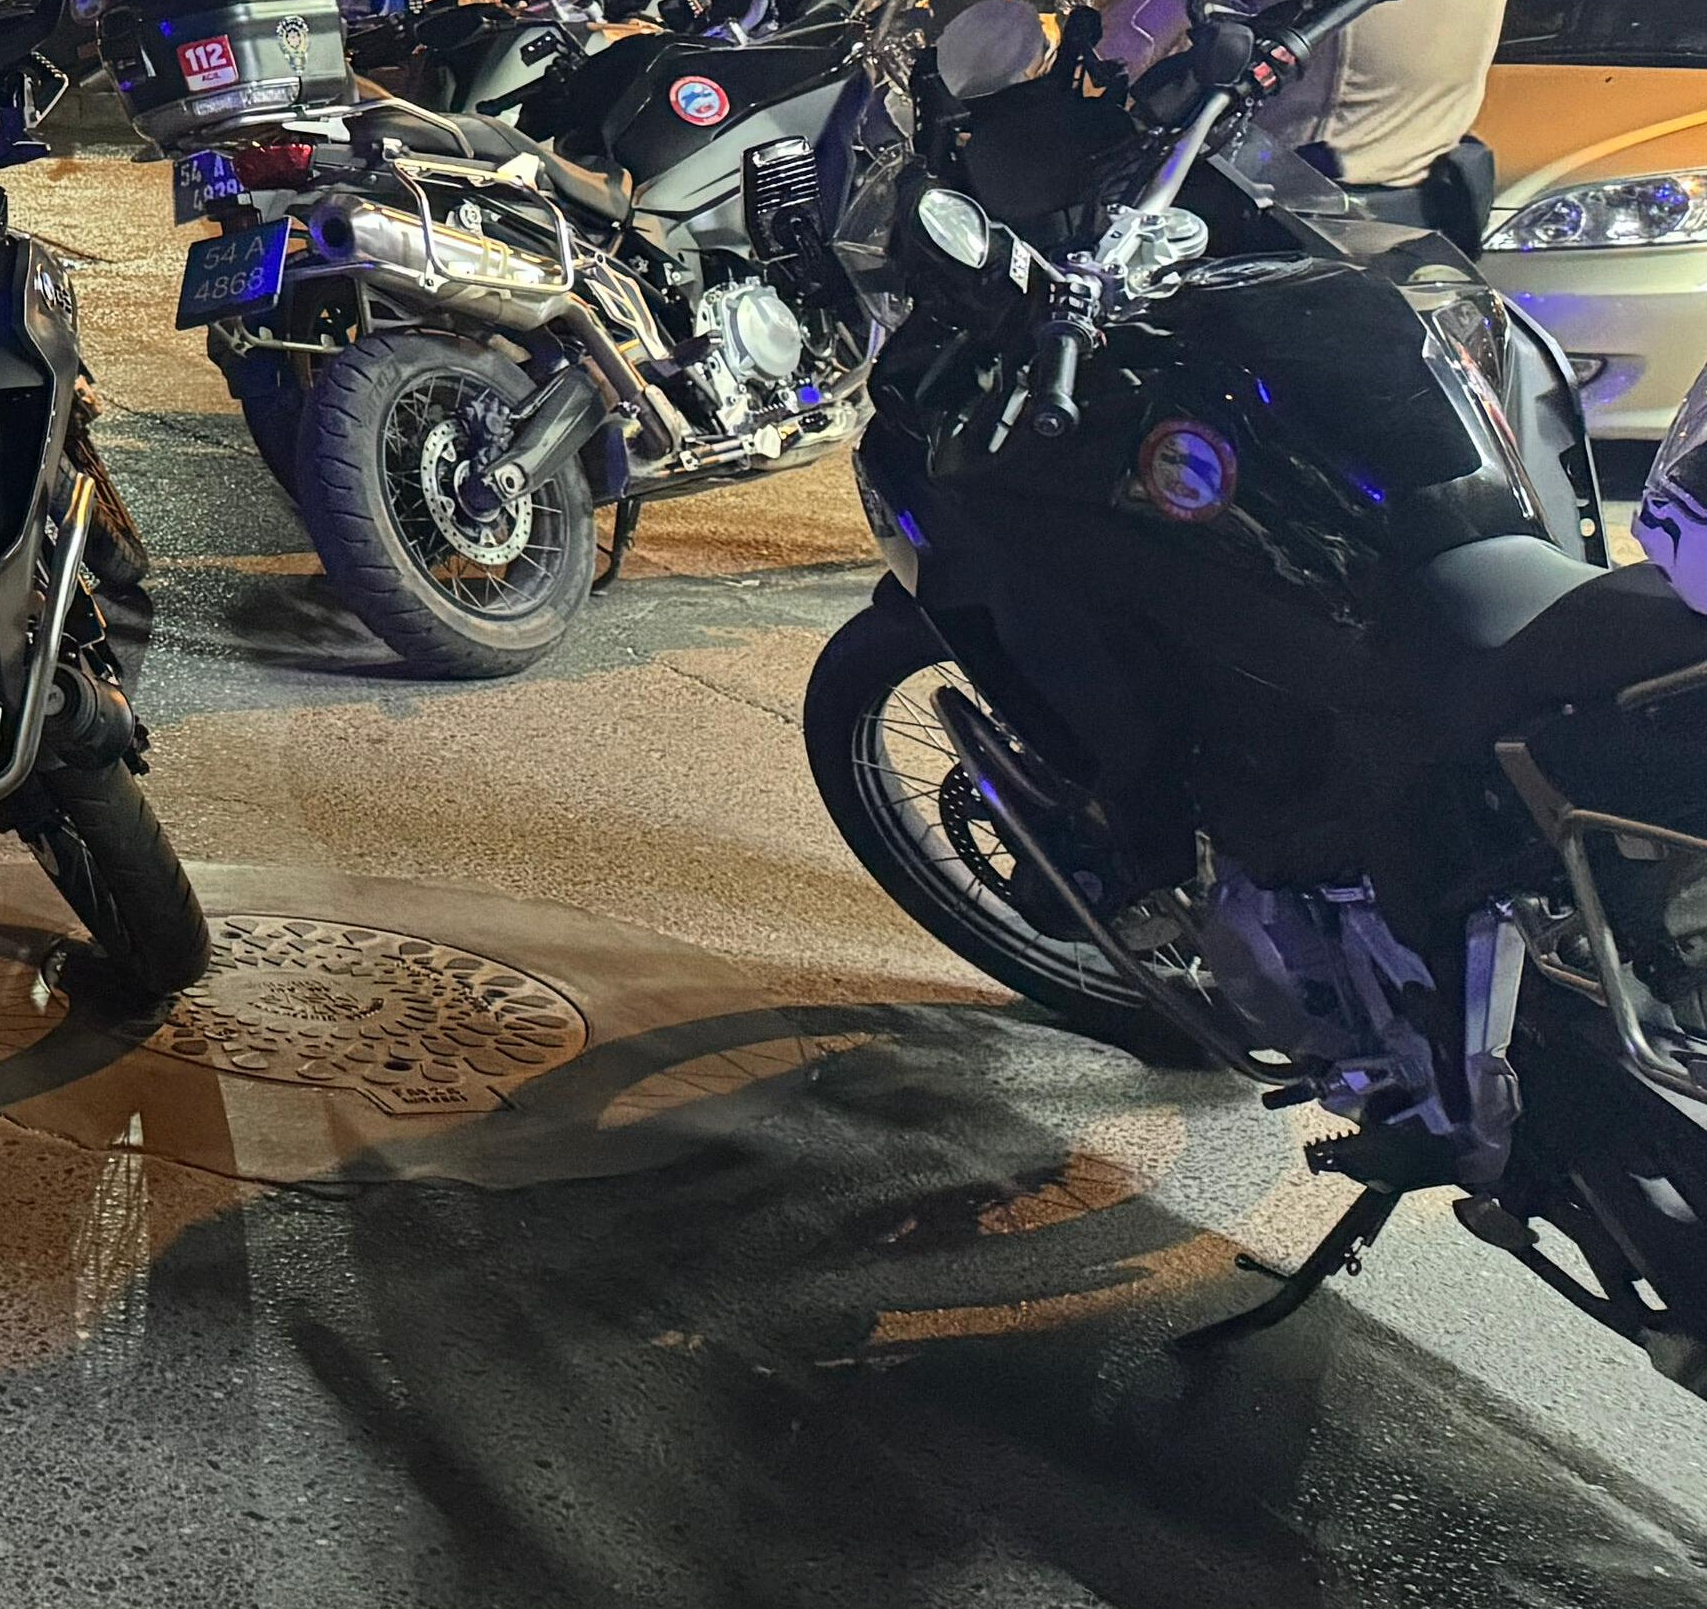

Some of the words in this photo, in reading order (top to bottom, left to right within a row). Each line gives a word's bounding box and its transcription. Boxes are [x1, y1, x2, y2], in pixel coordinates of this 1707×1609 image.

[185, 42, 228, 72] 112
[180, 160, 203, 188] 54
[213, 154, 226, 178] A
[203, 242, 236, 270] 54
[244, 236, 266, 262] A
[194, 266, 265, 302] 4868
